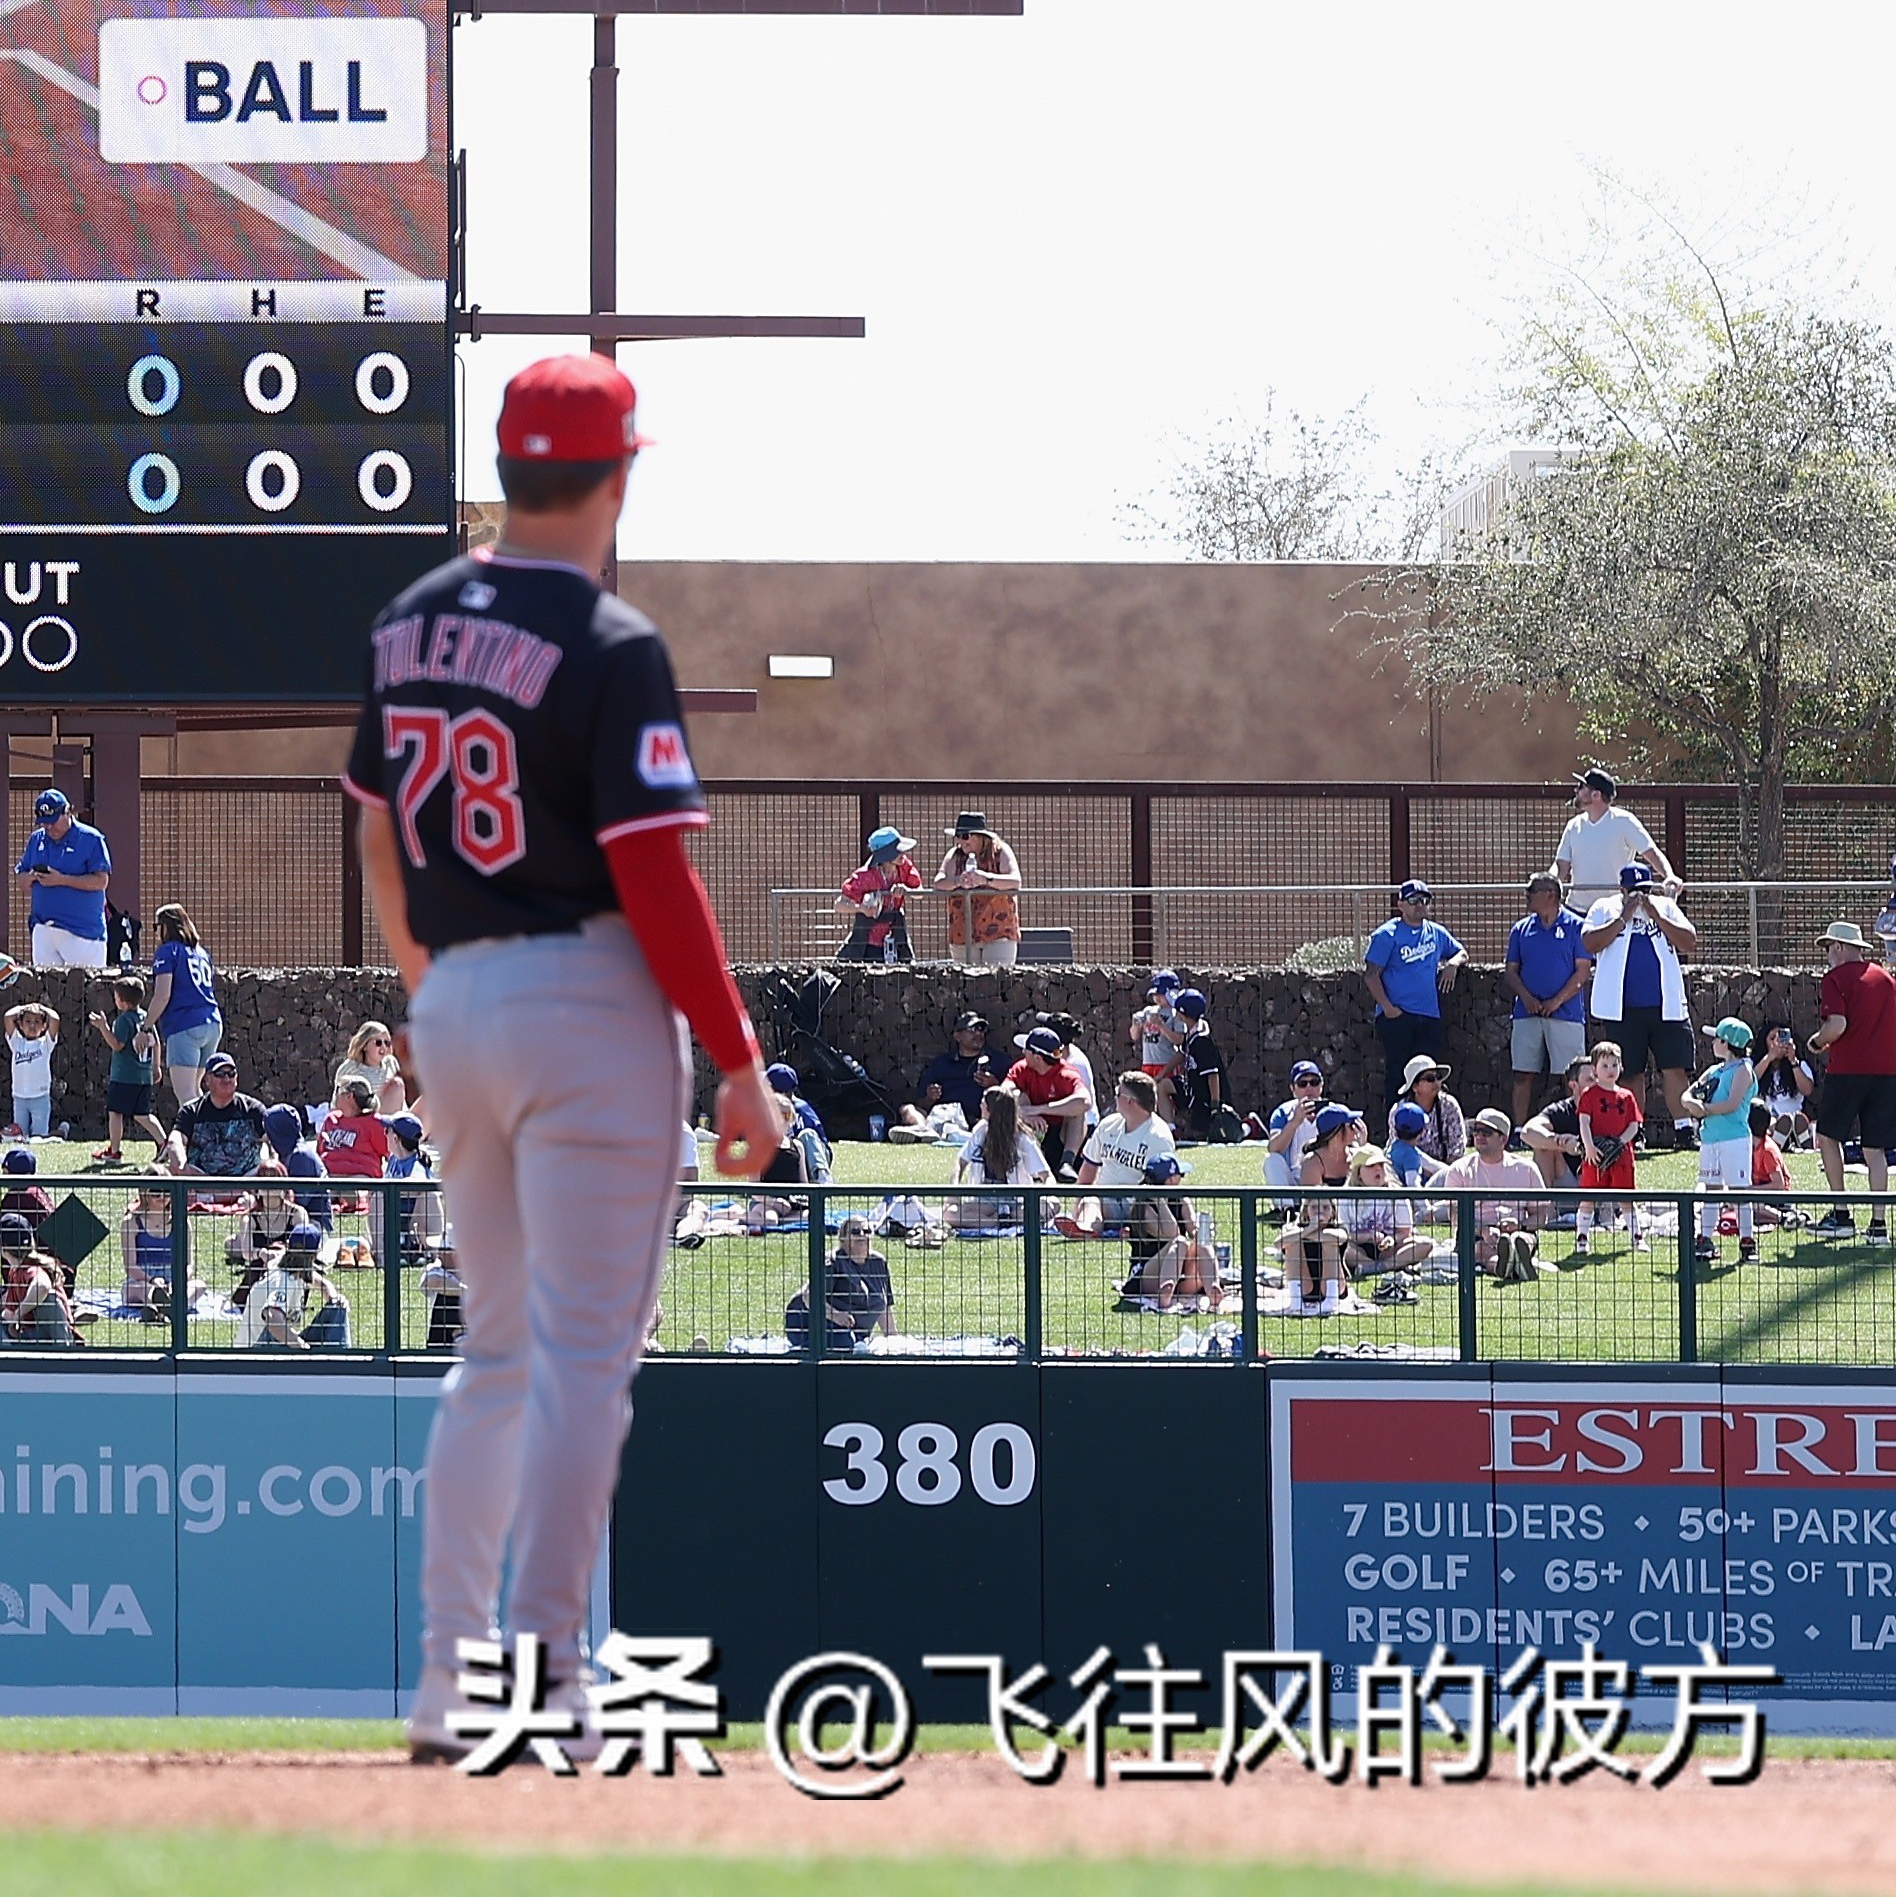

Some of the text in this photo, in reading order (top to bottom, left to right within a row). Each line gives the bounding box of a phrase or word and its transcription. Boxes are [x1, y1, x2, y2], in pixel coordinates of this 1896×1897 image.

[185, 60, 387, 123] BALL
[136, 290, 161, 318] R
[252, 290, 276, 318] H
[364, 290, 386, 318] E
[128, 354, 182, 417] 0
[243, 351, 299, 415] 0
[355, 351, 409, 414] 0
[127, 452, 181, 515] 0
[246, 449, 301, 513] 0
[357, 449, 413, 513] 0
[382, 704, 527, 877] 78
[187, 957, 212, 988] 50
[1400, 941, 1436, 963] Dodgers
[15, 1049, 43, 1065] Dodgers
[822, 1421, 1036, 1507] 380
[1343, 1502, 1896, 1545] 7 BUILDERS 50+ PARK
[1343, 1553, 1896, 1597] GOLF 65+ MILES OF TR
[1629, 1610, 1776, 1650] CLUBS
